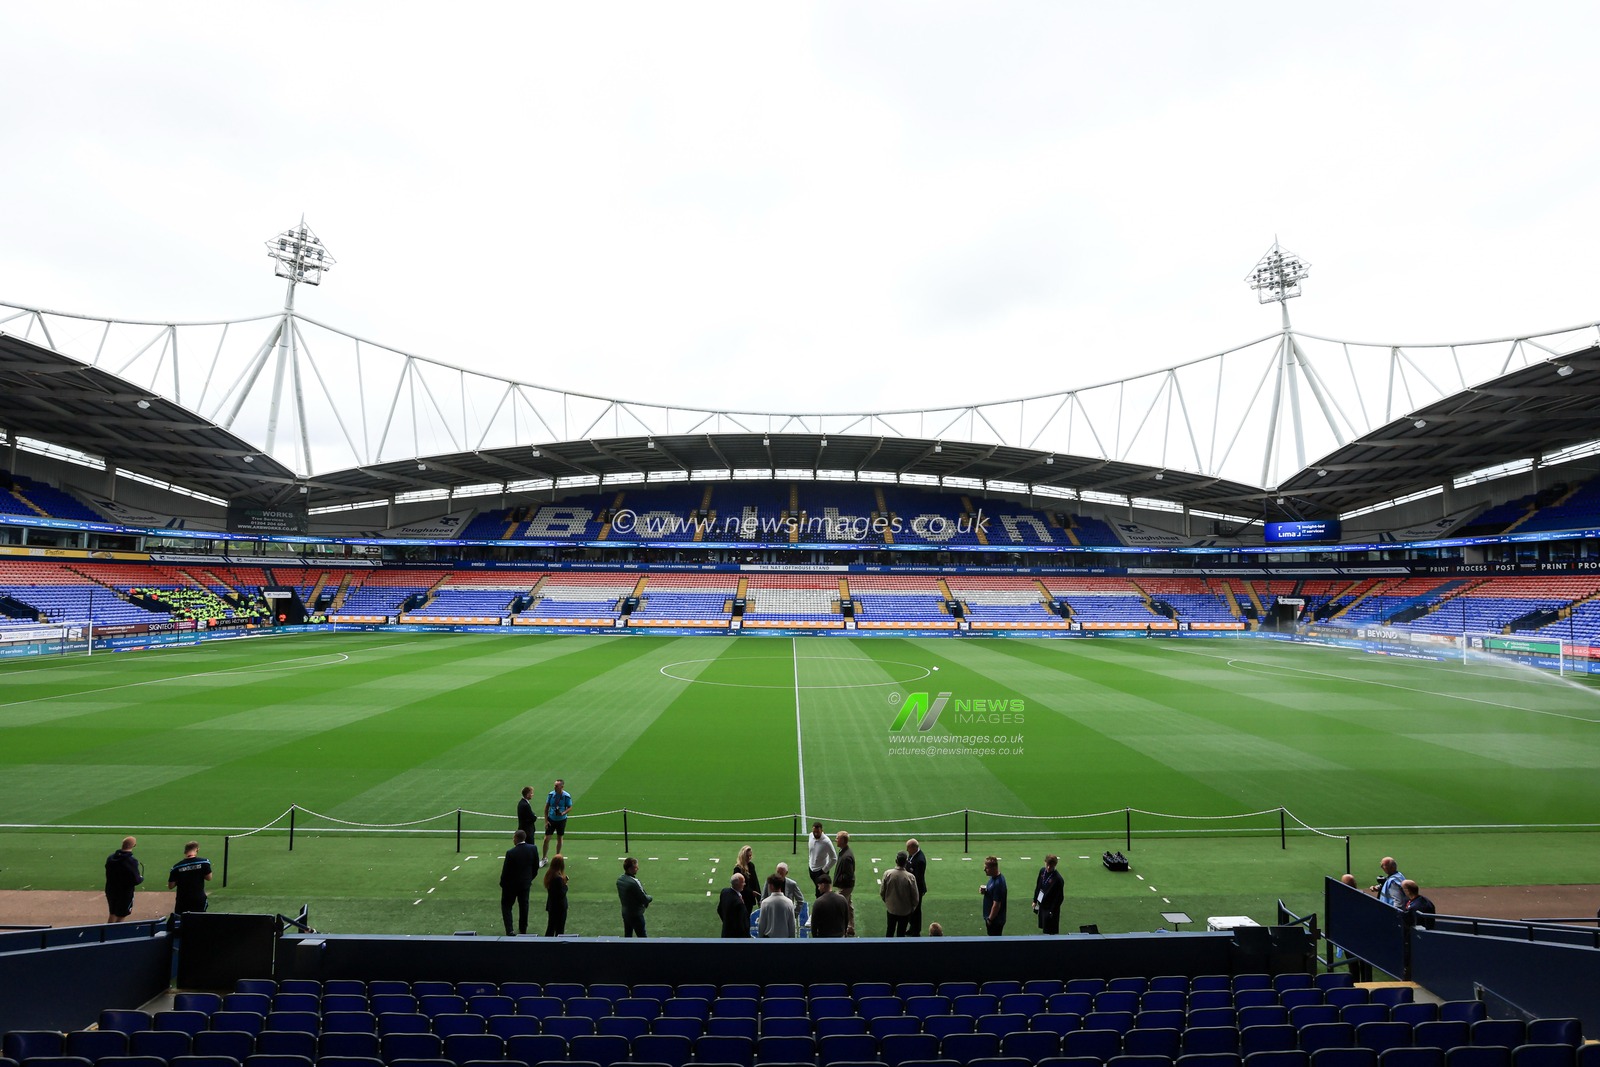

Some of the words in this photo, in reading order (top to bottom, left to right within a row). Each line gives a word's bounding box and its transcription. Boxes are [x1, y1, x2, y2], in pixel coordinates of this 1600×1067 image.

[1578, 562, 1600, 570] PRO
[148, 623, 175, 631] SIGNTECH
[1367, 630, 1398, 639] BEYOND
